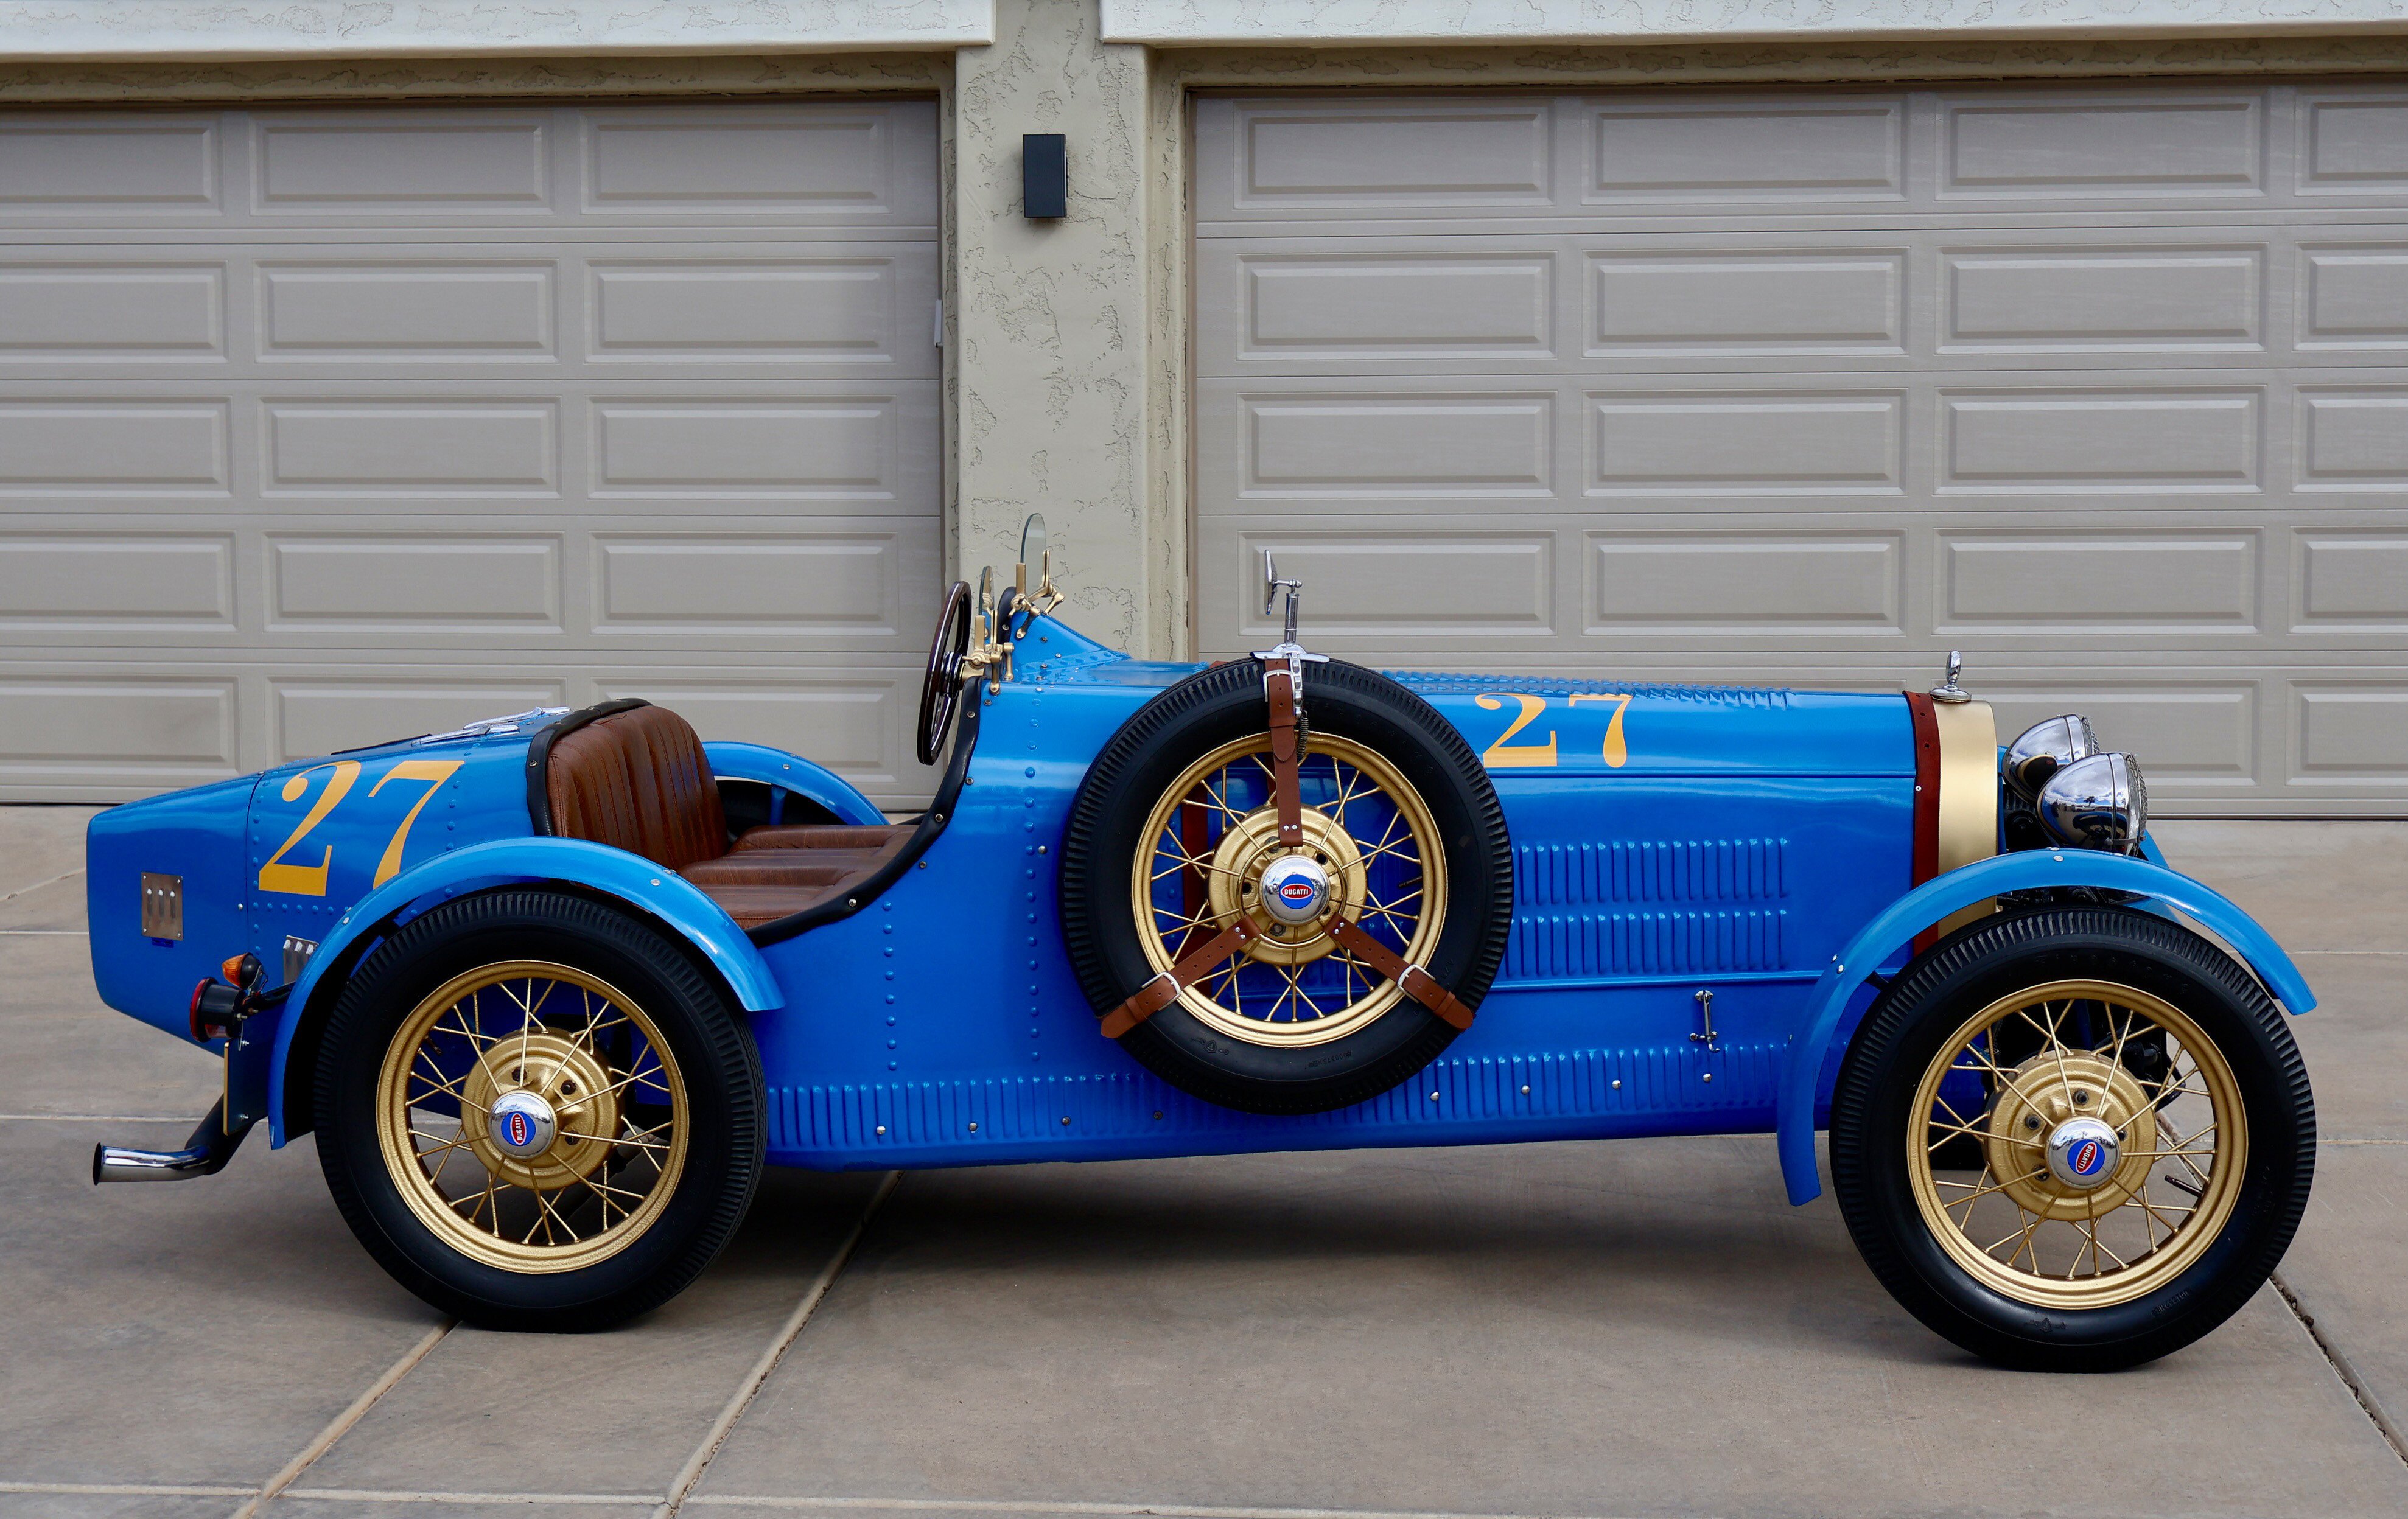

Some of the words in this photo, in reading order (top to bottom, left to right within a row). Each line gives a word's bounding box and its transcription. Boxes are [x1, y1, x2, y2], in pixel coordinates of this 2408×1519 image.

[1475, 693, 1633, 768] 27
[258, 760, 465, 897] 27
[514, 1117, 523, 1141] BUGATTI
[2077, 1145, 2094, 1170] BUGATTI
